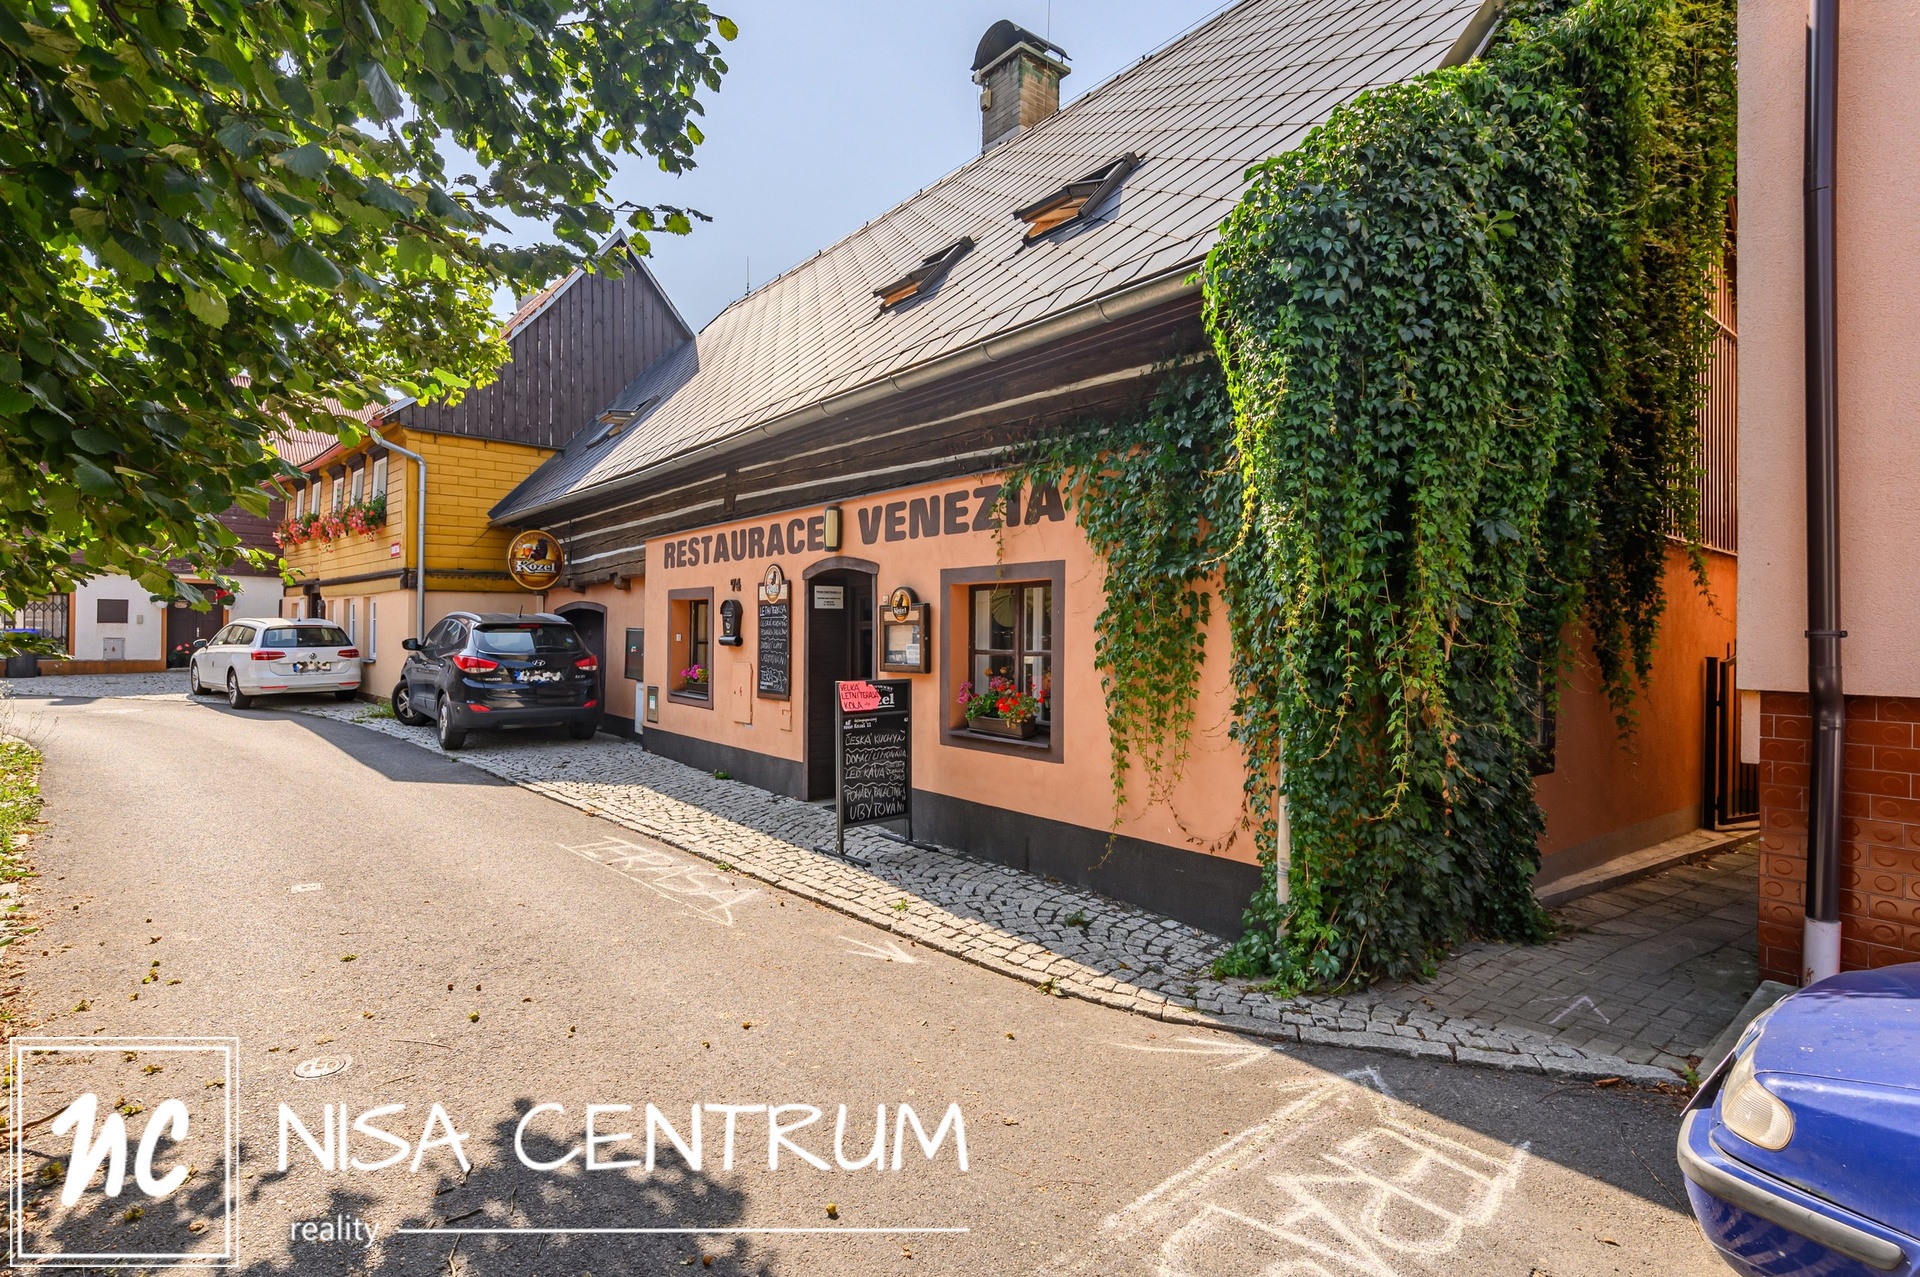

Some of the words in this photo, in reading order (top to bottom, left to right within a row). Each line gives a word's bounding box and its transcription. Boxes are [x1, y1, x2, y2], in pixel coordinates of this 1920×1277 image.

[664, 515, 825, 570] RESTAURACE
[858, 480, 1066, 546] VENEZIA
[515, 560, 557, 574] Kozel
[840, 682, 860, 692] VELKÁ
[844, 701, 863, 710] KOLA
[845, 732, 873, 746] ČESKÁ
[863, 764, 886, 779] KÁVA
